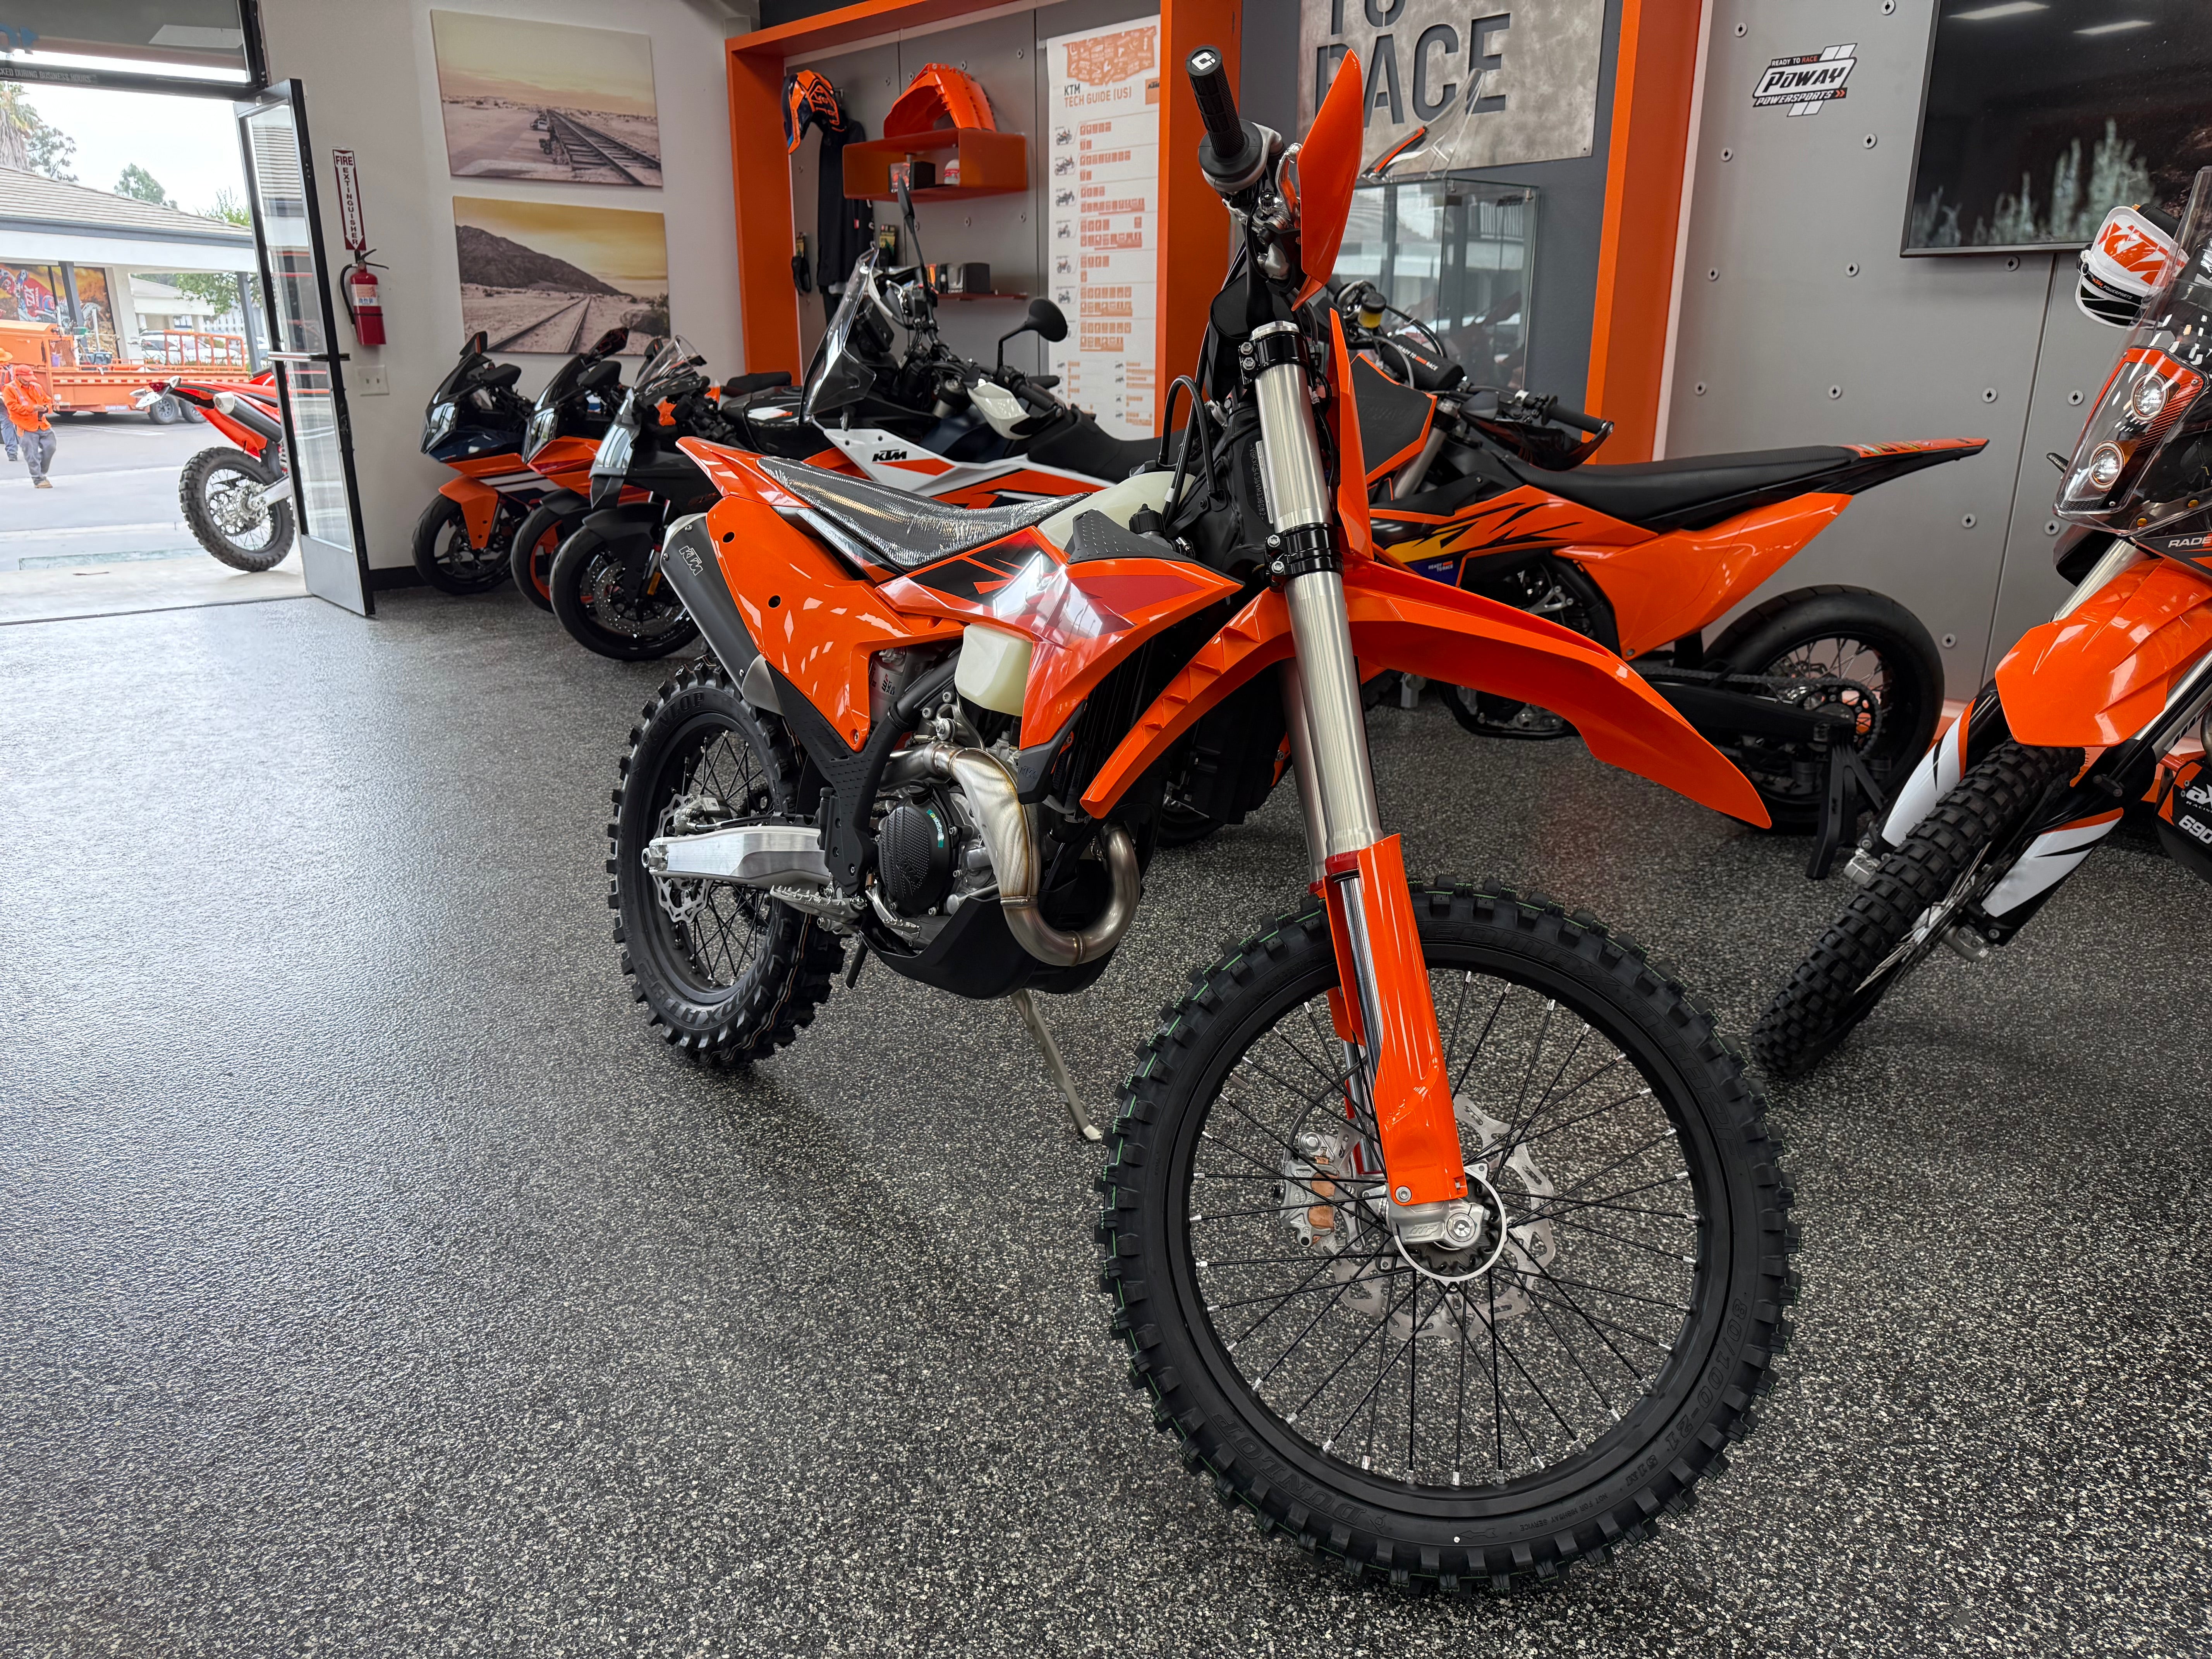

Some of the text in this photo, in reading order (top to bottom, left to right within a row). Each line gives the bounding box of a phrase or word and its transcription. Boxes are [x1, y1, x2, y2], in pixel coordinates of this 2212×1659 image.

[15, 69, 38, 78] DURING
[39, 71, 69, 81] BUSINESS
[70, 74, 91, 83] HOURS
[1762, 67, 1846, 93] POWAY
[1064, 86, 1132, 108] TECH GUIDE (US)
[1065, 83, 1080, 96] KTM
[1756, 90, 1834, 105] POWERSPORTS
[335, 156, 353, 166] FIRE
[343, 167, 358, 245] EXTINGUISHER
[2103, 284, 2133, 300] POWERPARTS
[1426, 361, 1438, 371] RACE
[872, 449, 907, 462] KTM
[2168, 536, 2212, 548] RADE
[678, 545, 703, 576] KTM
[2178, 815, 2212, 844] 690
[1666, 1298, 1748, 1452] 80/100-21
[1212, 1413, 1366, 1525] DUNLOP
[1626, 1455, 1658, 1486] 51M
[1582, 1500, 1594, 1511] FOR
[1595, 1492, 1609, 1505] NOT
[1520, 1519, 1548, 1532] SERVICE
